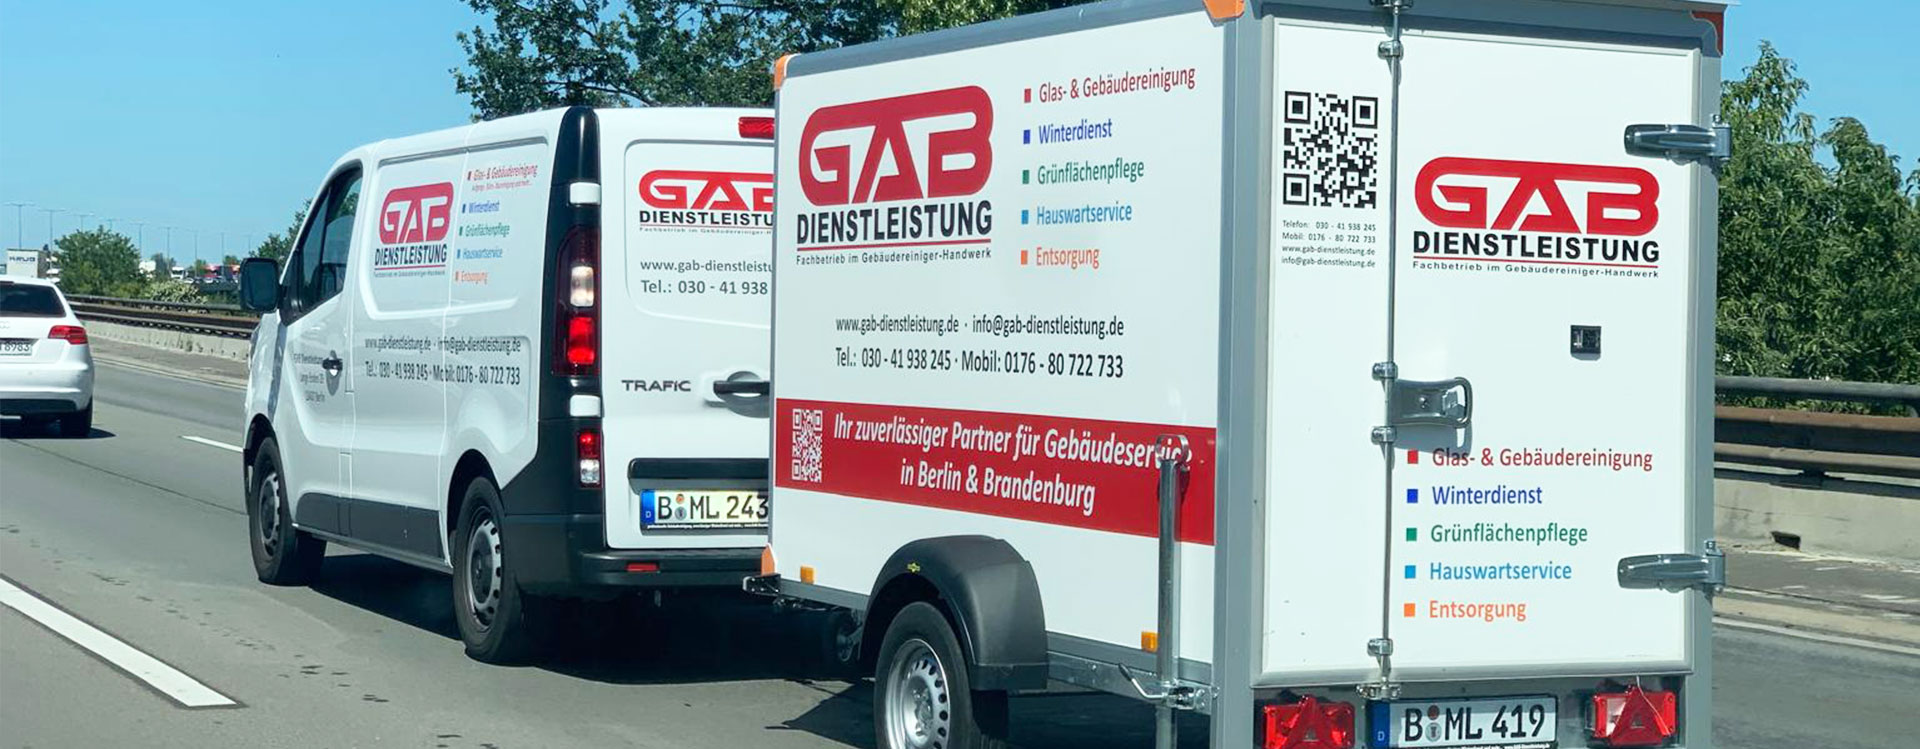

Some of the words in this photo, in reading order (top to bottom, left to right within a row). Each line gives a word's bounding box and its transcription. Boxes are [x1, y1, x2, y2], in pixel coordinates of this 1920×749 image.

[1039, 82, 1067, 103] Glas-
[1070, 78, 1080, 99] &
[1082, 66, 1196, 97] Gebäudereinigung
[1038, 118, 1113, 144] Winterdienst
[798, 85, 994, 206] GAB
[1037, 157, 1145, 185] Grünflächenpflege
[1415, 156, 1660, 237] GAB
[379, 182, 455, 245] GAB
[797, 199, 993, 244] DIENSTLEISTUNG
[1036, 201, 1133, 226] Hauswartservice
[1281, 232, 1305, 240] Mobil:
[1308, 233, 1325, 241] 0176
[1335, 234, 1344, 242] 80
[1347, 235, 1360, 243] 722
[1363, 235, 1376, 244] 733
[1282, 220, 1310, 229] Telefon:
[1315, 221, 1329, 230] 030
[1337, 222, 1345, 230] 41
[1363, 223, 1376, 232] 245
[374, 243, 448, 266] DIENSTLEISTUNG
[796, 253, 846, 266] Fachbetrieb
[848, 253, 859, 264] im
[861, 247, 992, 264] Gebäudereiniger-Handwerk
[1036, 247, 1100, 270] Entsorgung
[1281, 245, 1376, 257] www.gab-dienstleistung.de
[1413, 231, 1660, 263] DIENSTLEISTUNG
[1281, 256, 1376, 268] info@gab-dienstleistung.de
[1412, 261, 1483, 271] Fachbetrieb
[1487, 263, 1500, 272] im
[1505, 264, 1660, 278] Gebäudereiniger-Handwerk
[640, 280, 672, 293] Tel.:
[678, 280, 706, 294] 030
[719, 281, 737, 294] 41
[741, 281, 768, 295] 938
[836, 314, 959, 337] www.gab-dienstleistung.de
[972, 314, 1125, 339] info@gab-dienstleistung.de
[379, 362, 390, 378] 030
[395, 362, 402, 379] 41
[403, 363, 415, 380] 938
[416, 363, 429, 381] 245
[456, 365, 474, 383] 0176
[479, 366, 488, 384] 80
[490, 366, 504, 384] 722
[506, 366, 521, 385] 733
[836, 347, 857, 367] Tel.:
[861, 348, 881, 368] 030
[890, 348, 904, 368] 41
[907, 349, 928, 370] 938
[930, 349, 951, 371] 245
[961, 350, 1001, 373] Mobil:
[1004, 352, 1036, 375] 0176
[1048, 353, 1064, 376] 80
[1068, 353, 1094, 378] 722
[1098, 354, 1124, 379] 733
[621, 380, 692, 392] TRAFIC
[833, 412, 853, 439] Ihr
[854, 416, 948, 453] zuverlässiger
[951, 421, 1012, 453] Partner
[1012, 424, 1041, 461] für
[1432, 448, 1475, 467] Glas-
[1481, 448, 1494, 466] &
[1500, 448, 1653, 472] Gebäudereinigung
[900, 458, 914, 485] in
[917, 460, 961, 491] Berlin
[965, 465, 978, 494] &
[982, 467, 1096, 517] Brandenburg
[1432, 485, 1543, 505] Winterdienst
[657, 496, 672, 520] B
[690, 496, 719, 519] ML
[726, 496, 769, 519] 243
[1430, 523, 1588, 546] Grünflächenpflege
[1430, 561, 1572, 580] Hauswartservice
[1429, 600, 1526, 623] Entsorgung
[1405, 708, 1423, 742] B
[1445, 707, 1483, 741] ML
[1492, 704, 1545, 738] 419
